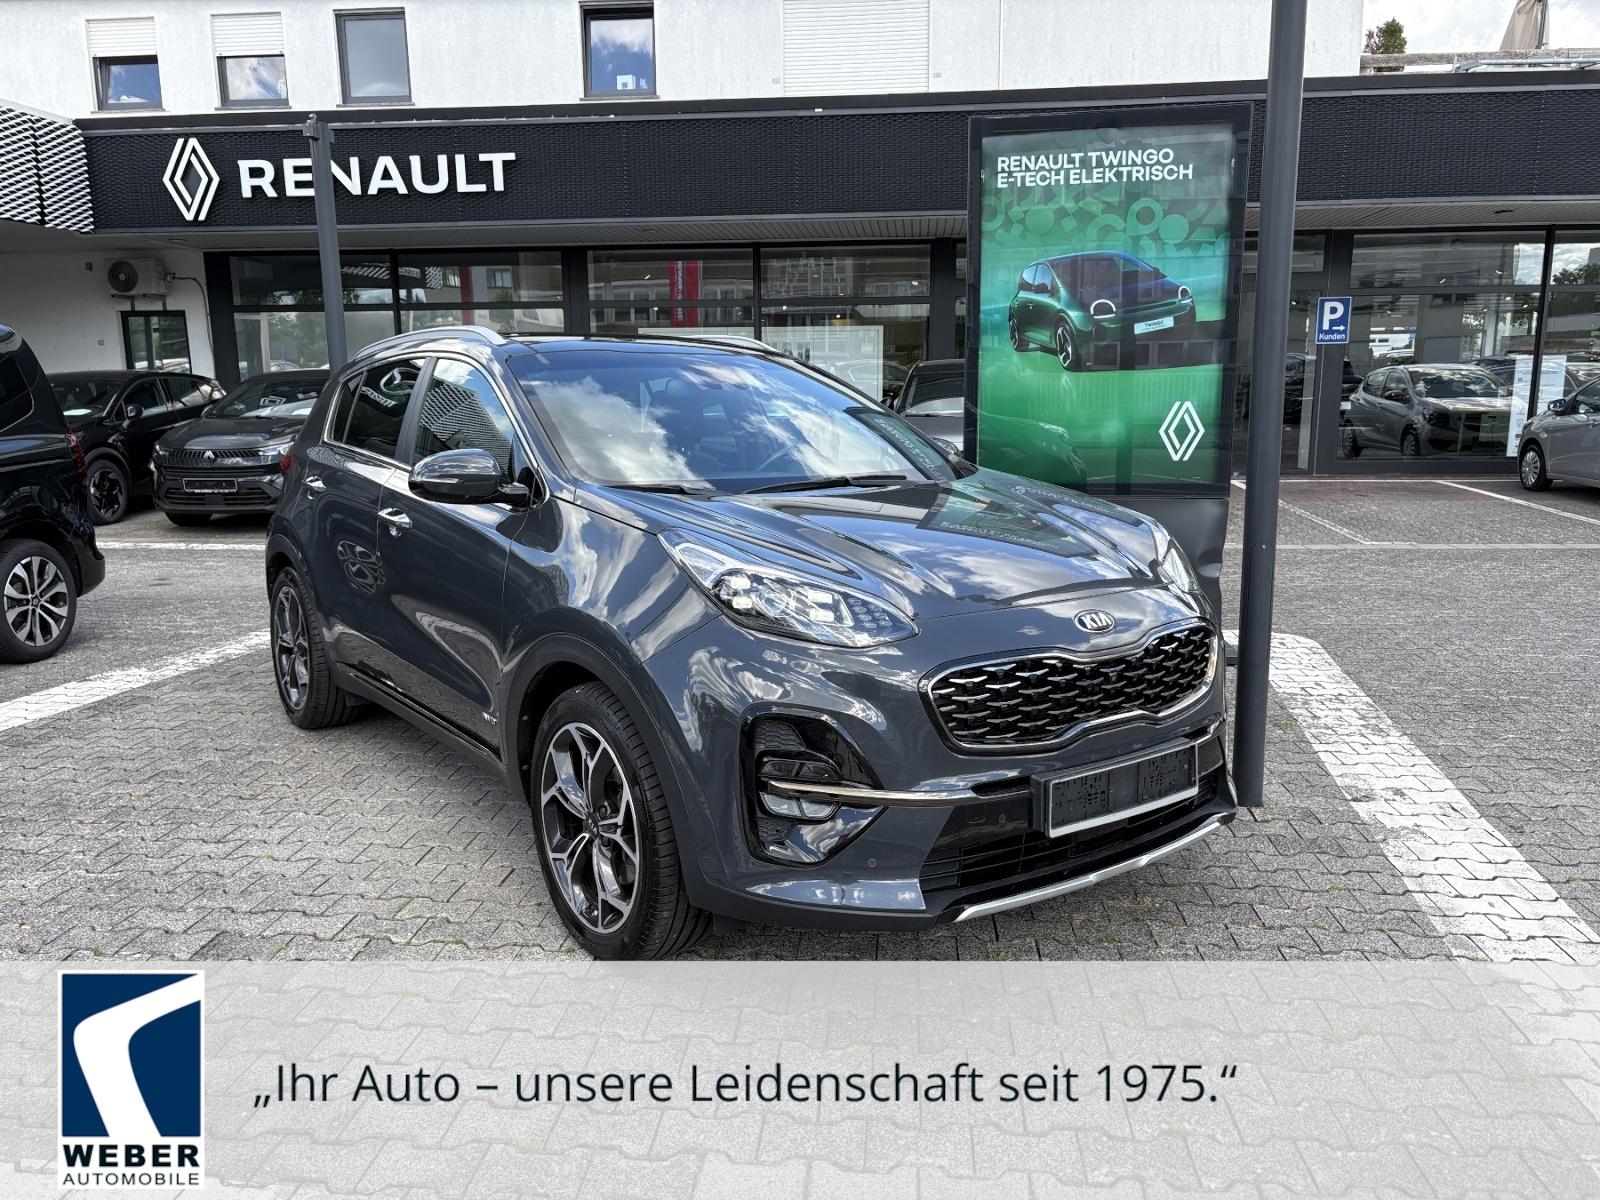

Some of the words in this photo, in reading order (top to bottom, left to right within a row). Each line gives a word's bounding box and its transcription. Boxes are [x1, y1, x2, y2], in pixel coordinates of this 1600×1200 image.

[997, 152, 1084, 172] RENAULT
[1087, 148, 1175, 167] TWINGO
[237, 152, 516, 198] RENAULT
[997, 168, 1065, 188] E-TECH
[1069, 164, 1194, 185] ELEKTRISCH
[1323, 301, 1344, 330] P
[1318, 332, 1346, 341] Kunden
[1080, 612, 1112, 630] KIA
